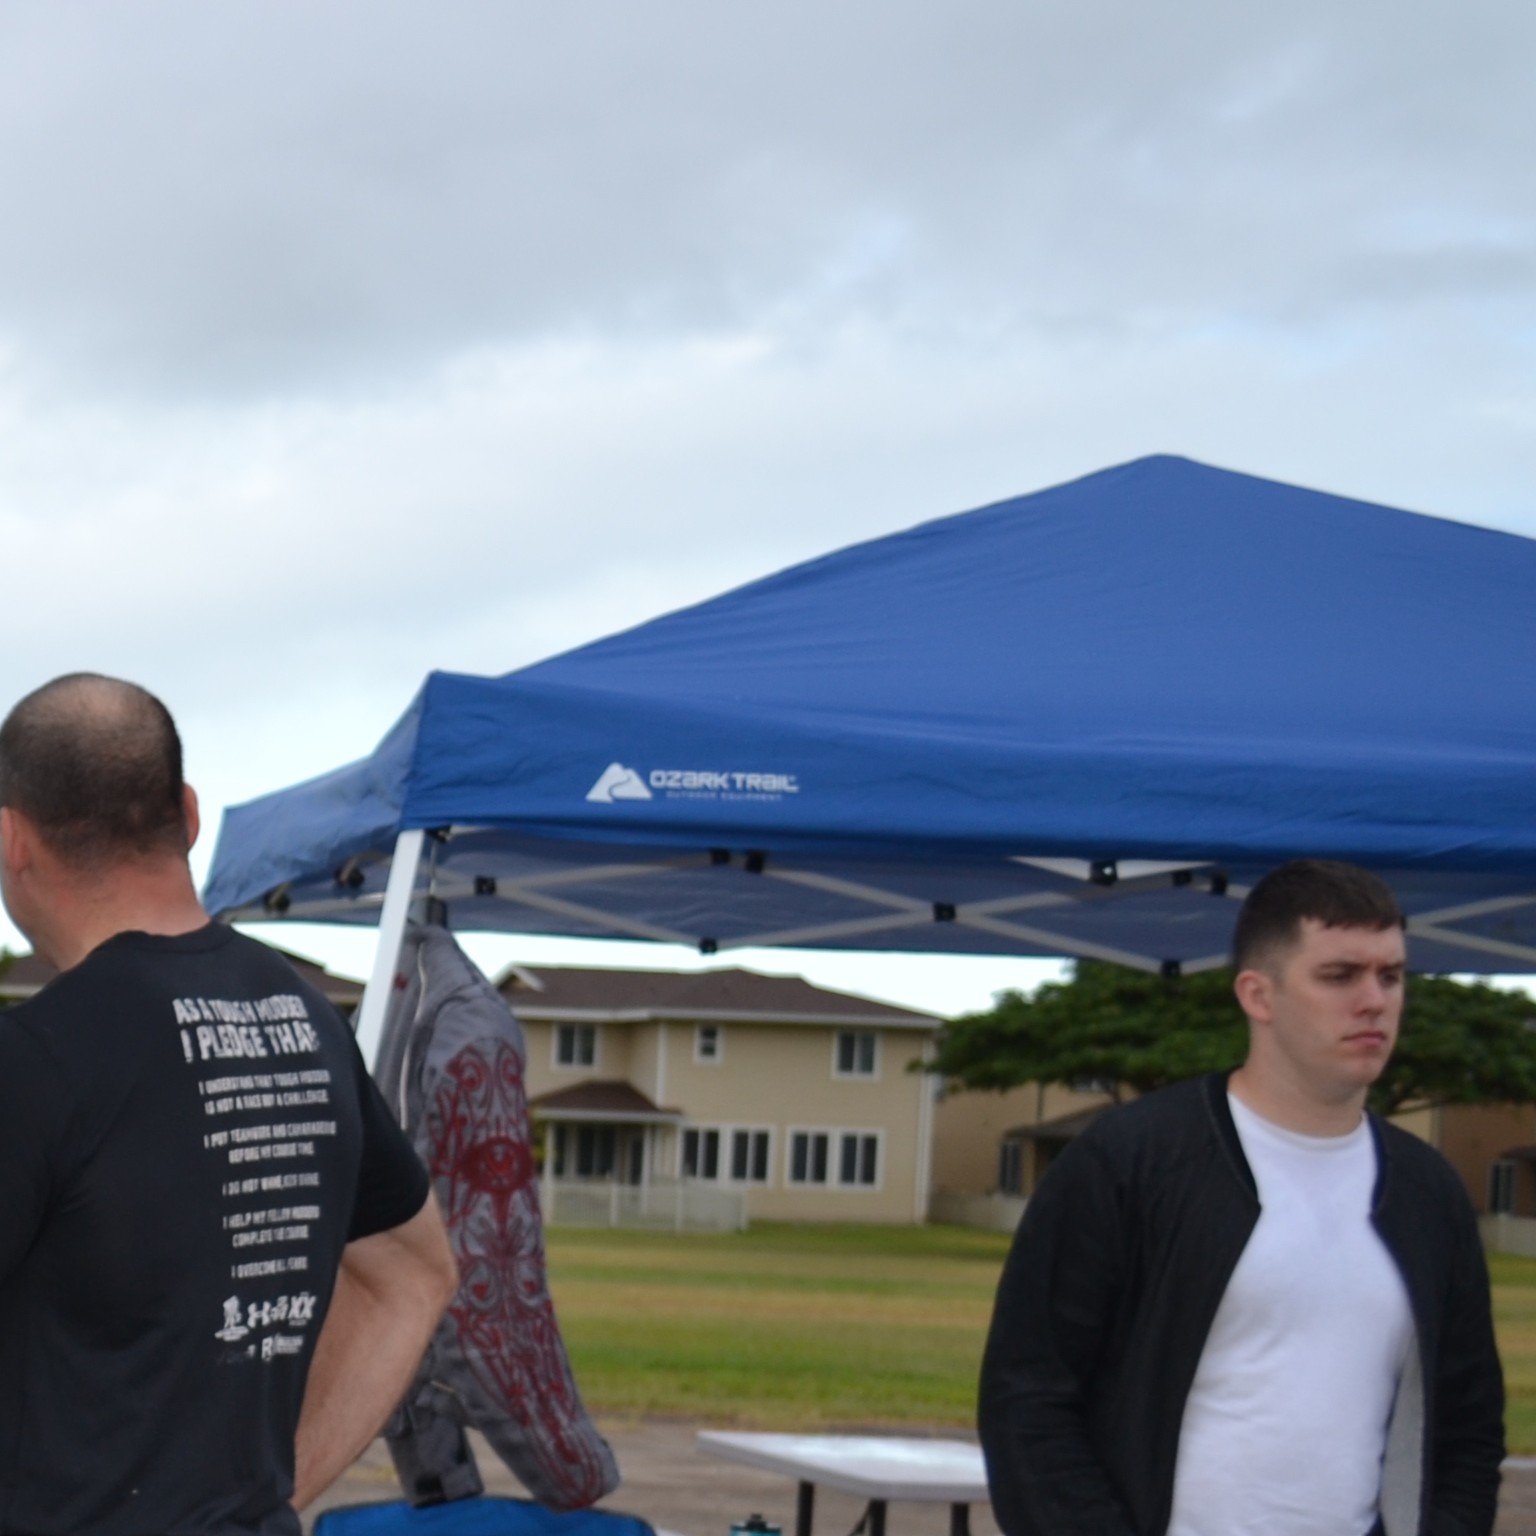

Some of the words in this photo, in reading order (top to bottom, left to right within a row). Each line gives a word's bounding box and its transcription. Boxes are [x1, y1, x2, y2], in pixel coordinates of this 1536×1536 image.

[650, 770, 729, 789] OZARK
[730, 773, 799, 793] TRAIL
[173, 998, 201, 1024] AS
[180, 1029, 193, 1063] I
[196, 1024, 268, 1060] PLEDGE
[229, 1212, 251, 1228] HELP
